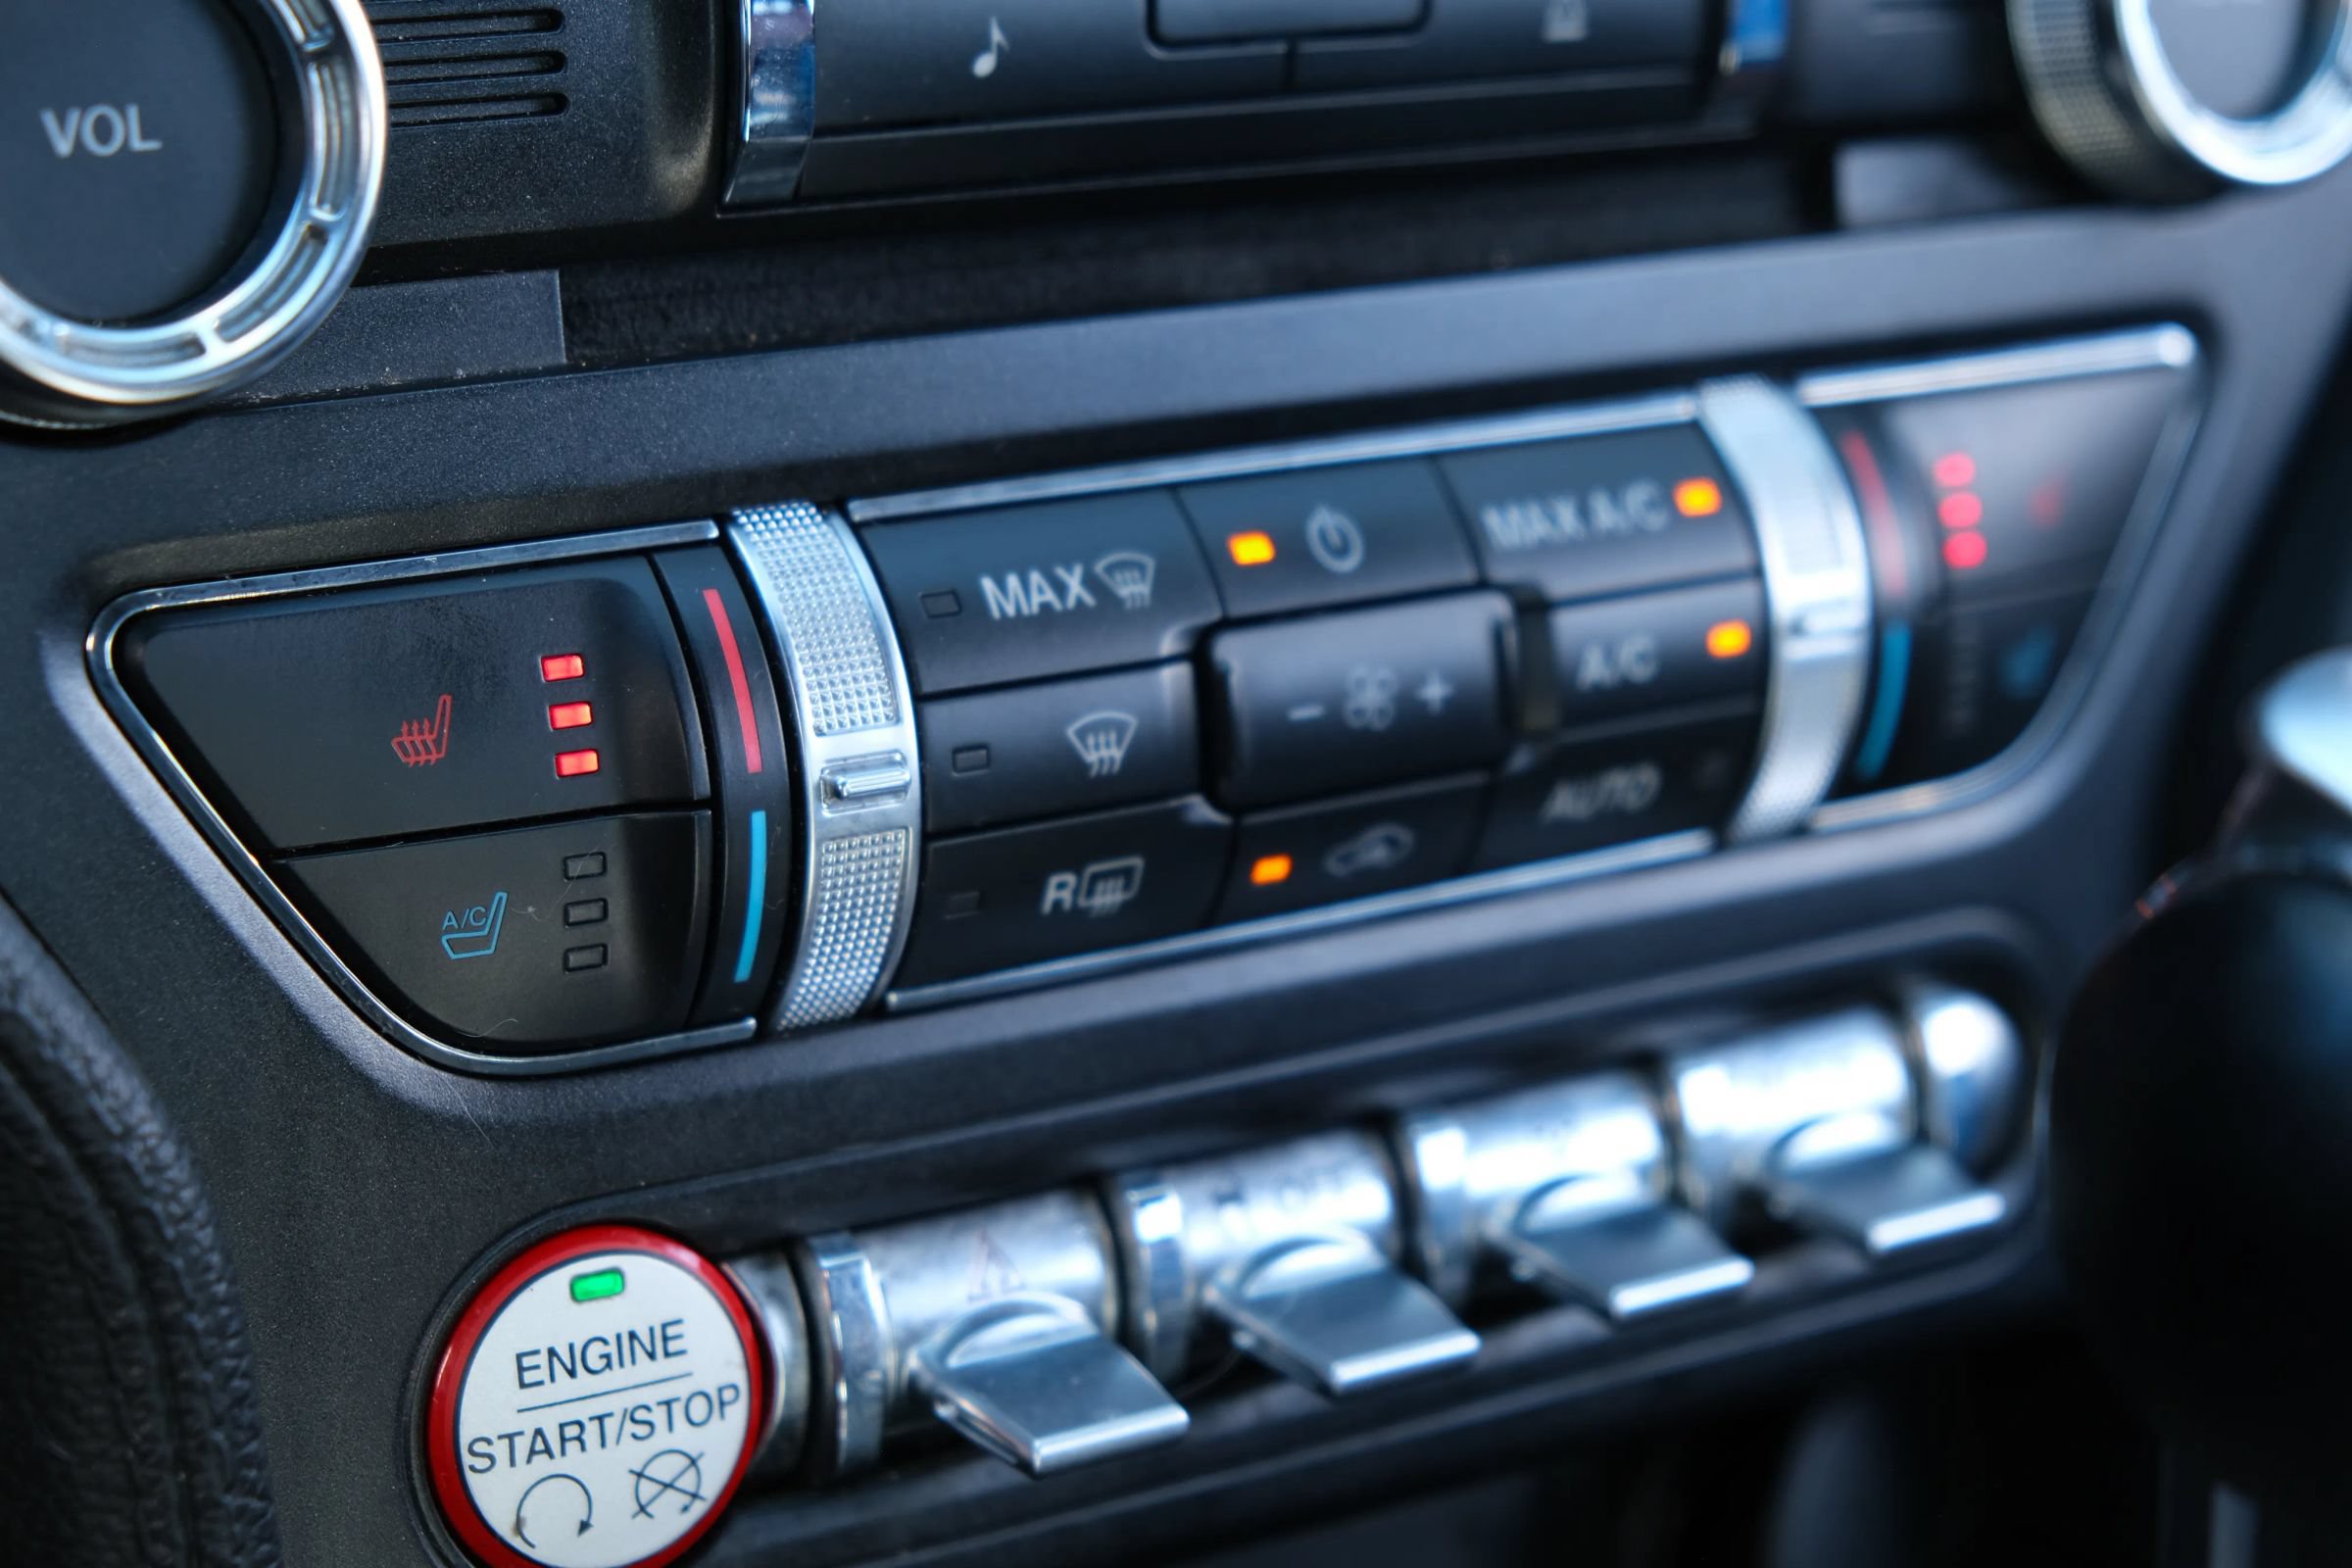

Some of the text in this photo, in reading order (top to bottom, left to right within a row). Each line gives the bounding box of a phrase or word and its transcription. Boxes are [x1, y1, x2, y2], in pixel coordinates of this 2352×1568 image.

[40, 103, 162, 157] VOL
[1482, 478, 1667, 550] MAX A/C
[980, 564, 1096, 620] MAX
[1576, 637, 1658, 690] A/C
[1542, 762, 1661, 822] AUTO
[441, 906, 488, 931] A/C
[1042, 875, 1075, 915] R
[515, 1319, 687, 1389] ENGINE
[467, 1383, 741, 1474] START/STOP
